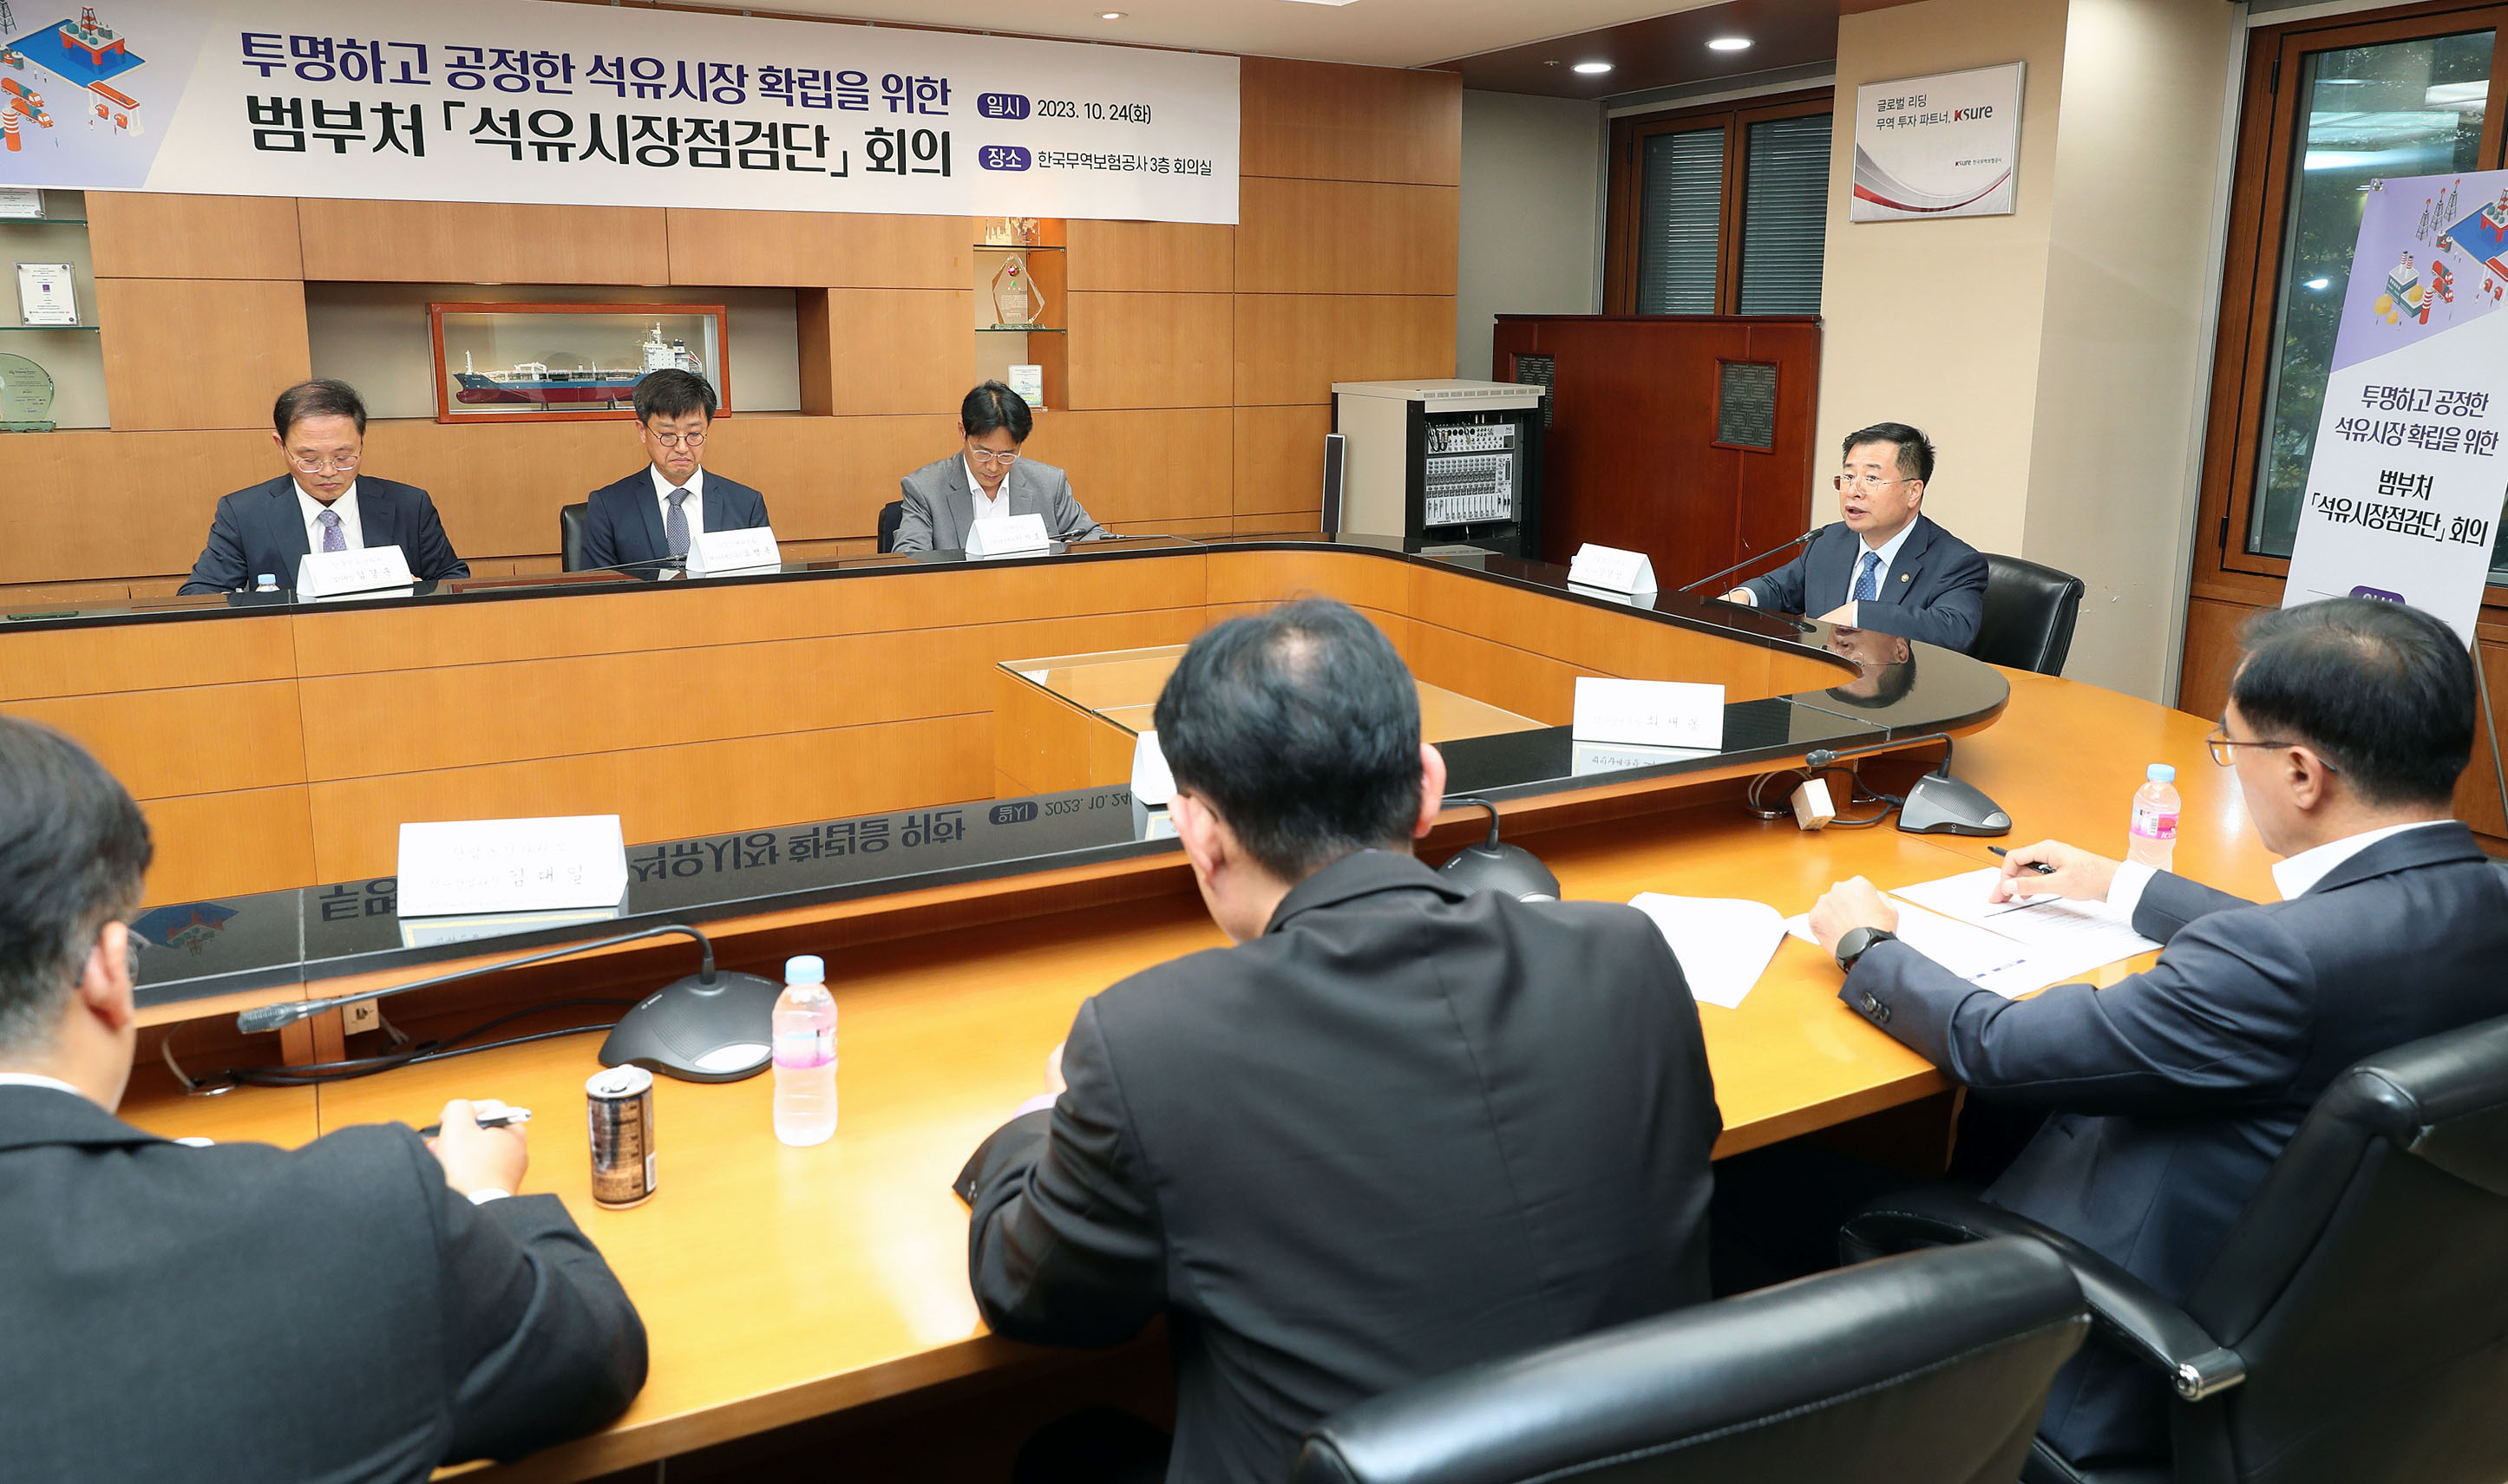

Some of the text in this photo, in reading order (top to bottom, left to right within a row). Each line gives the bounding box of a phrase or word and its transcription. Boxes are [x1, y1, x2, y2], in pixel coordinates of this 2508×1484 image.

[241, 31, 952, 115] 투명하고 공정한 석유시장 확립을 위한
[986, 95, 1151, 124] 일시 2023. 10. 24(화)
[1876, 116, 1895, 130] 무역
[1897, 115, 1916, 129] 투자
[1954, 105, 1993, 121] Ksure
[1877, 94, 1927, 113] 글로벌 리딩
[246, 95, 951, 177] 범부처 「석유시장점검단」 회의
[987, 147, 1212, 176] 장소 한국무역보험공사 3층 회의실
[2361, 385, 2489, 418] 투명하고 공정한
[2334, 416, 2498, 456] 석유시장 확립을 위한
[2378, 469, 2433, 500] 범부처
[2311, 492, 2489, 546] 「석유시장점검단」 회의
